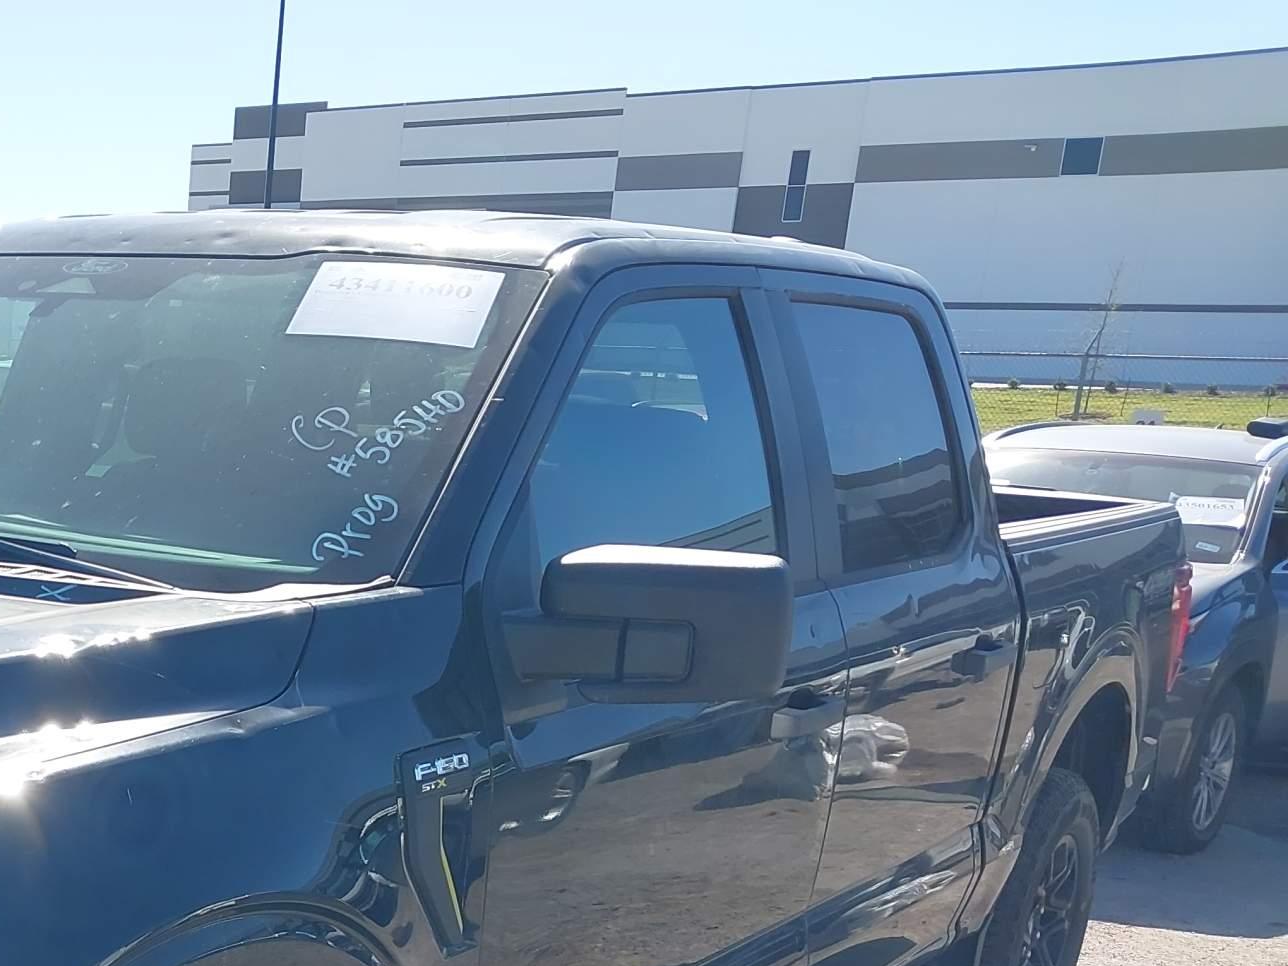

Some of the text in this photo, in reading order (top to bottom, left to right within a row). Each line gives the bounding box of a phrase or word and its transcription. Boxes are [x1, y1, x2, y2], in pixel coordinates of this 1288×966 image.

[328, 276, 473, 299] 43411600
[312, 493, 398, 560] Prog
[414, 753, 470, 781] F-150
[422, 776, 447, 793] STX
